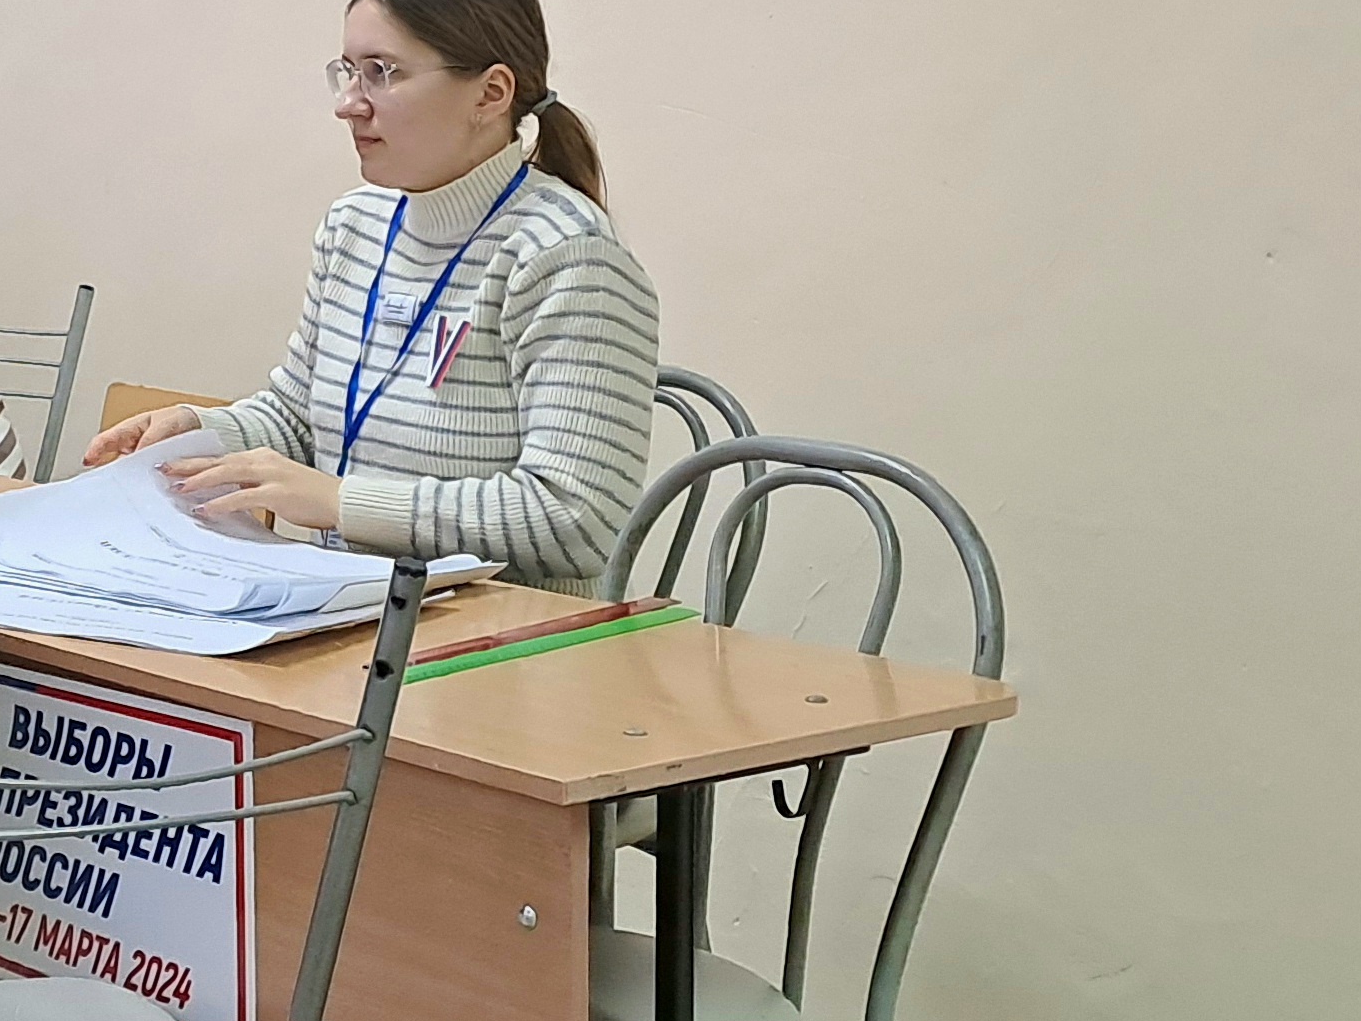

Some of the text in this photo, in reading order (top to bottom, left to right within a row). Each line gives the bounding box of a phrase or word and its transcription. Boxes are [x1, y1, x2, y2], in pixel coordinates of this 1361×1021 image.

[8, 705, 173, 791] ВЫБОРЫ
[33, 914, 123, 986] МАРТА
[123, 949, 193, 1011] 2024
